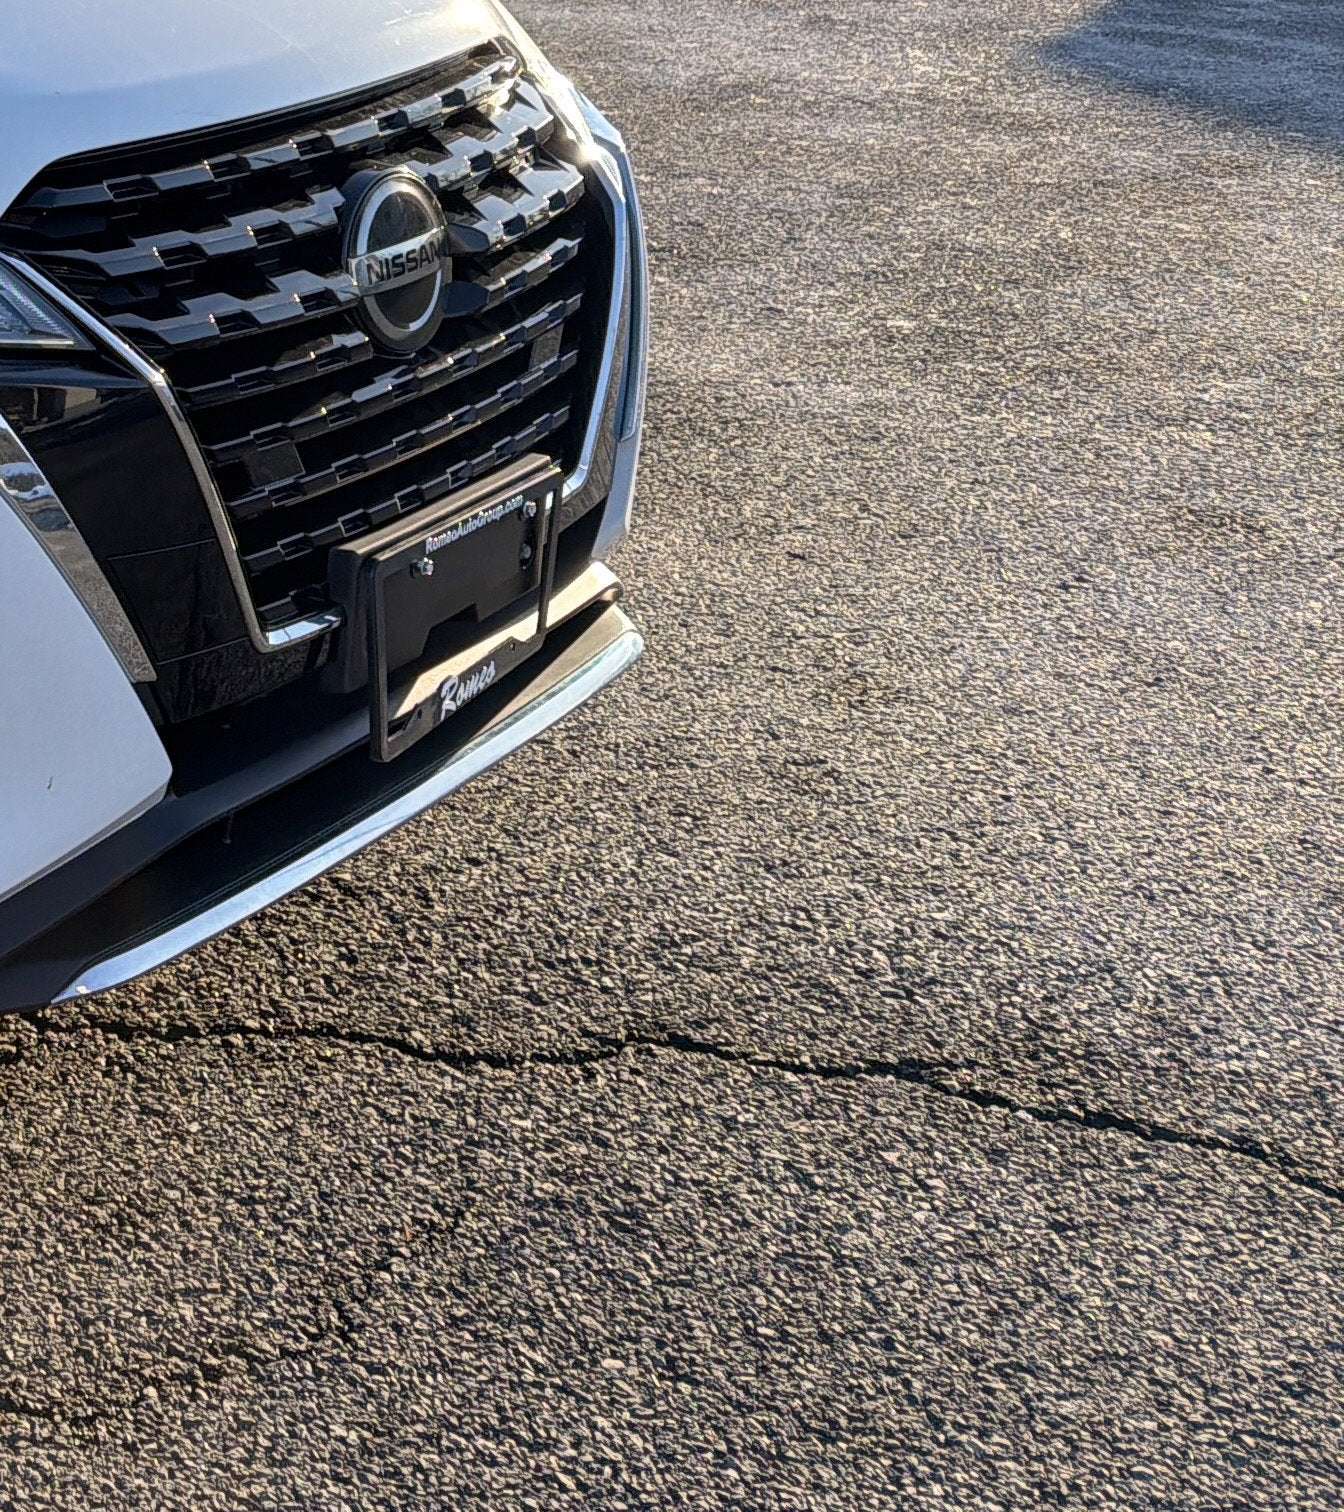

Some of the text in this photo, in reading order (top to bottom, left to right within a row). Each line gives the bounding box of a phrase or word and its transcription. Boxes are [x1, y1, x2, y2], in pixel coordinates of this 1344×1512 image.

[366, 236, 449, 285] NISSAN
[425, 494, 524, 555] RomeoAutoGroup.com
[440, 660, 496, 722] Romeo
